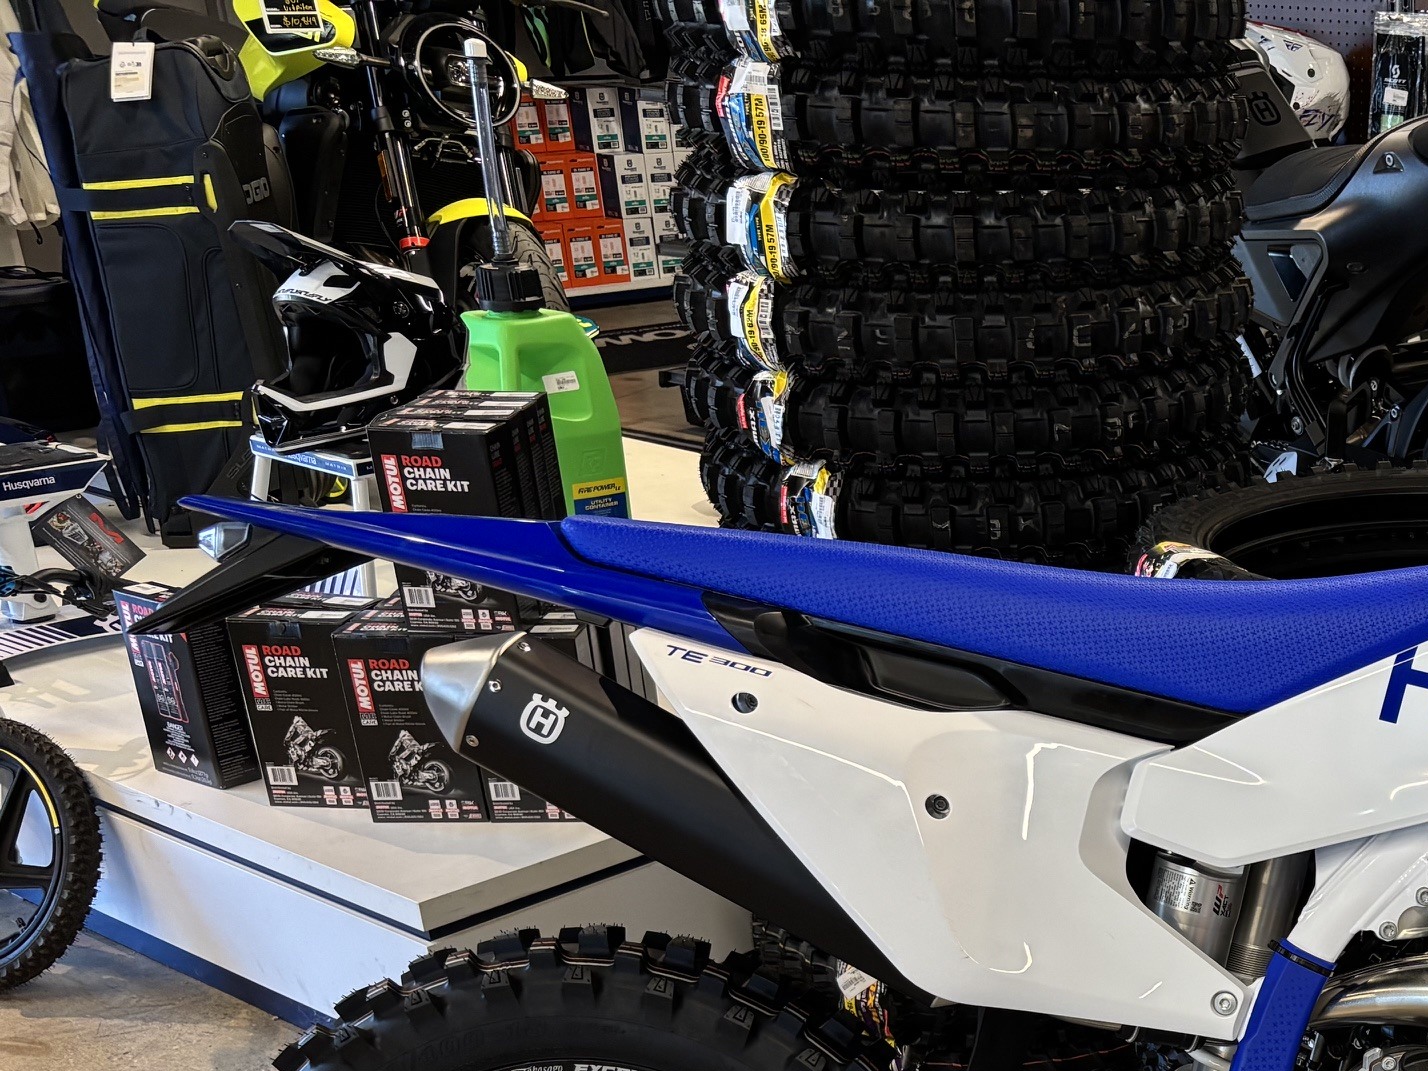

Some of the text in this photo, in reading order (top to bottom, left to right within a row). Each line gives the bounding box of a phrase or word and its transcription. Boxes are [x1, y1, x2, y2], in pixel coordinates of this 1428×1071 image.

[401, 456, 442, 468] ROAD
[403, 468, 451, 480] CHAIN
[2, 475, 56, 492] Husqvarna
[384, 455, 407, 512] MOTUL
[406, 481, 470, 493] CARE KIT
[262, 645, 302, 656] ROAD
[264, 656, 310, 668] CHAIN
[369, 659, 410, 670] ROAD
[667, 644, 773, 677] TE 300
[244, 645, 268, 697] MOTUL
[267, 667, 329, 679] CARE KIT
[371, 670, 419, 681] CHAIN
[350, 660, 373, 711] MOTUL
[373, 681, 413, 692] CARE
